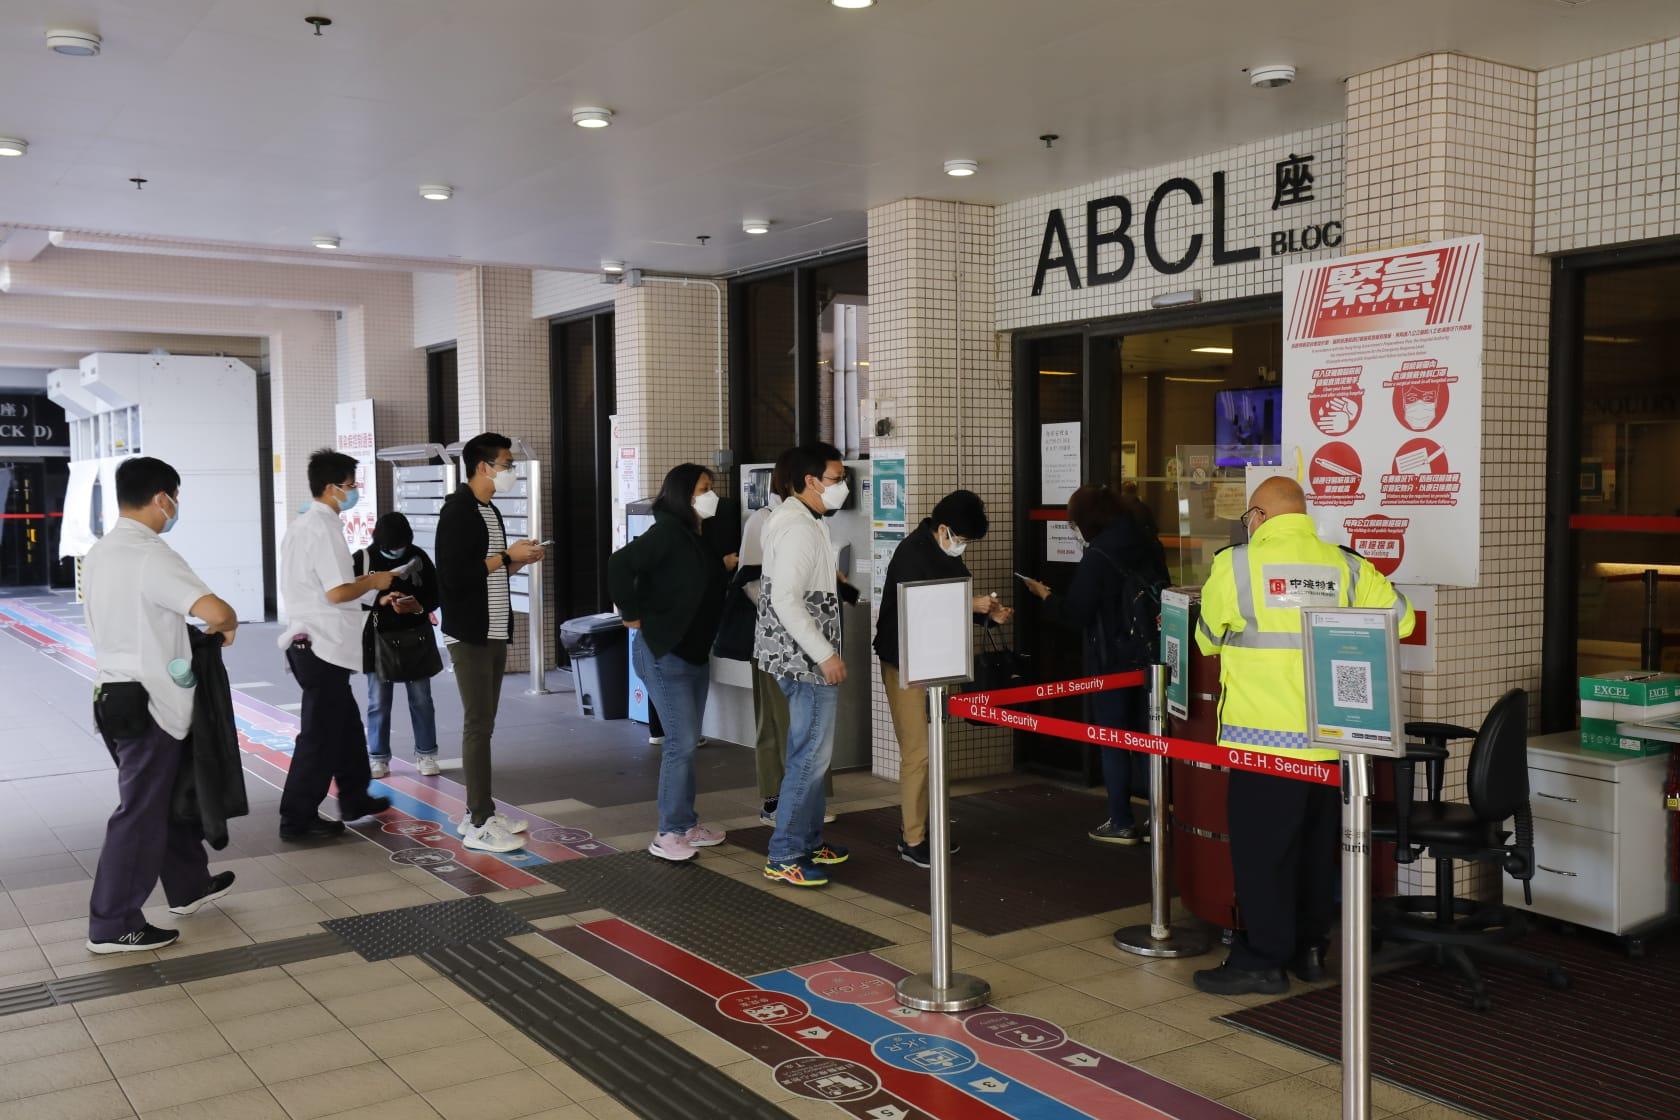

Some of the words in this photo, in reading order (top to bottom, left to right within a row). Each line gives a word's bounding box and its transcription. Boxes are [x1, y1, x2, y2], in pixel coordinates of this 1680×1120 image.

[1272, 153, 1314, 210] 座
[1031, 170, 1260, 296] ABCL
[1271, 221, 1342, 256] BLOC
[1321, 253, 1441, 308] 緊急
[1036, 683, 1067, 697] Q.E.H.
[1068, 678, 1104, 692] Security
[1593, 684, 1629, 697] EXCEL
[1649, 687, 1670, 698] EXCEL
[970, 704, 999, 721] Q.E.H.
[1001, 711, 1038, 731] Security
[1087, 726, 1121, 744] Q.E.H.
[1124, 732, 1169, 754] Security
[1229, 750, 1271, 769] Q.E.H.
[1274, 758, 1330, 782] Security
